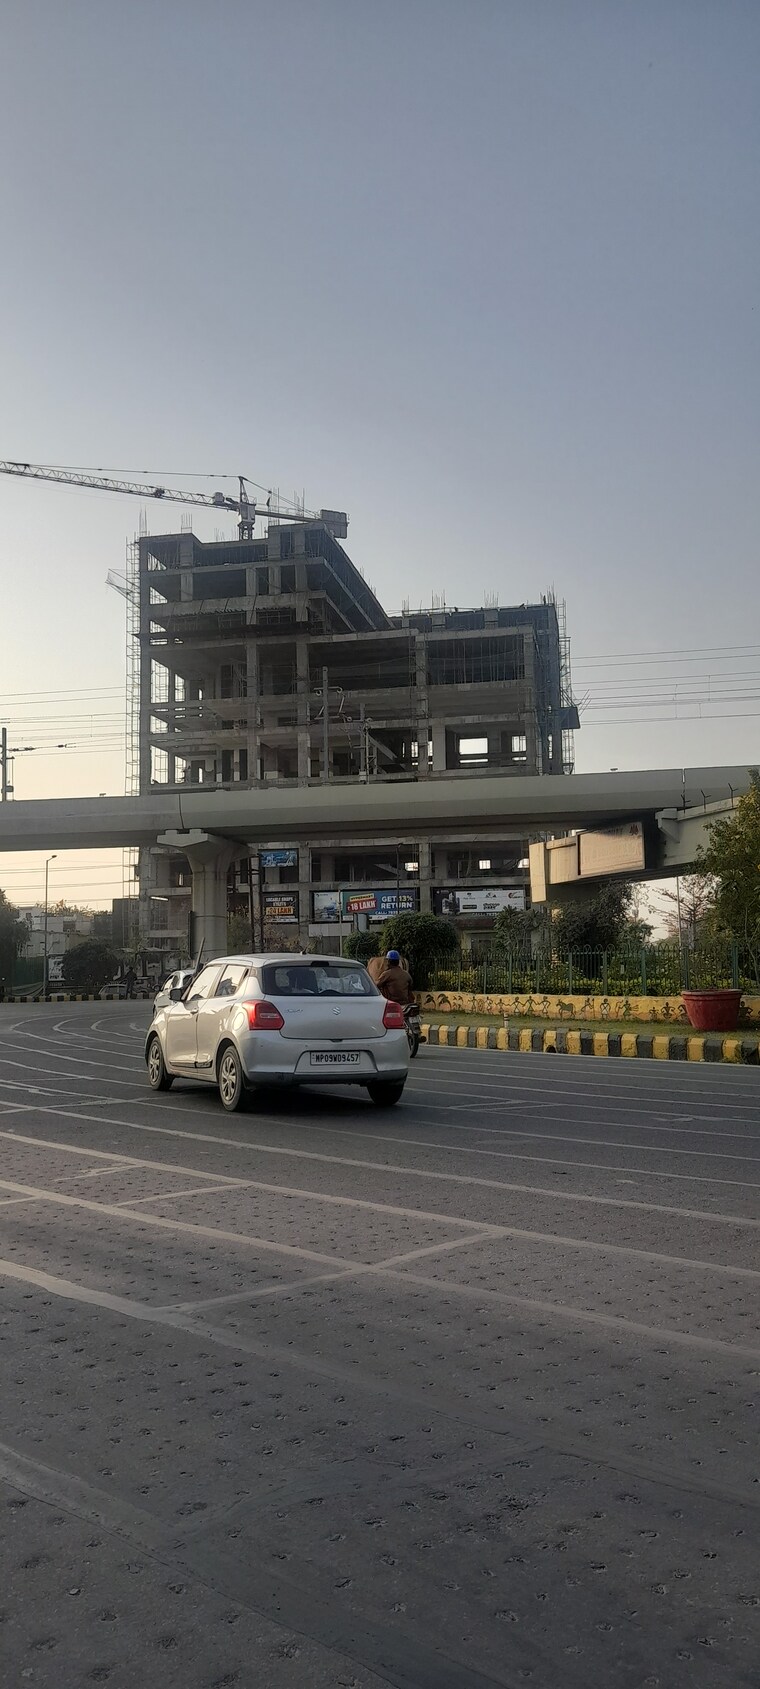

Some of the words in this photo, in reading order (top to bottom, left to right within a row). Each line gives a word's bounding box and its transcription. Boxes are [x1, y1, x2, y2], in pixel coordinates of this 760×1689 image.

[381, 895, 397, 903] GET
[398, 895, 413, 903] 13%
[359, 900, 376, 910] LAKH
[381, 902, 413, 910] RETURN
[315, 1053, 359, 1063] MP09WD9457
